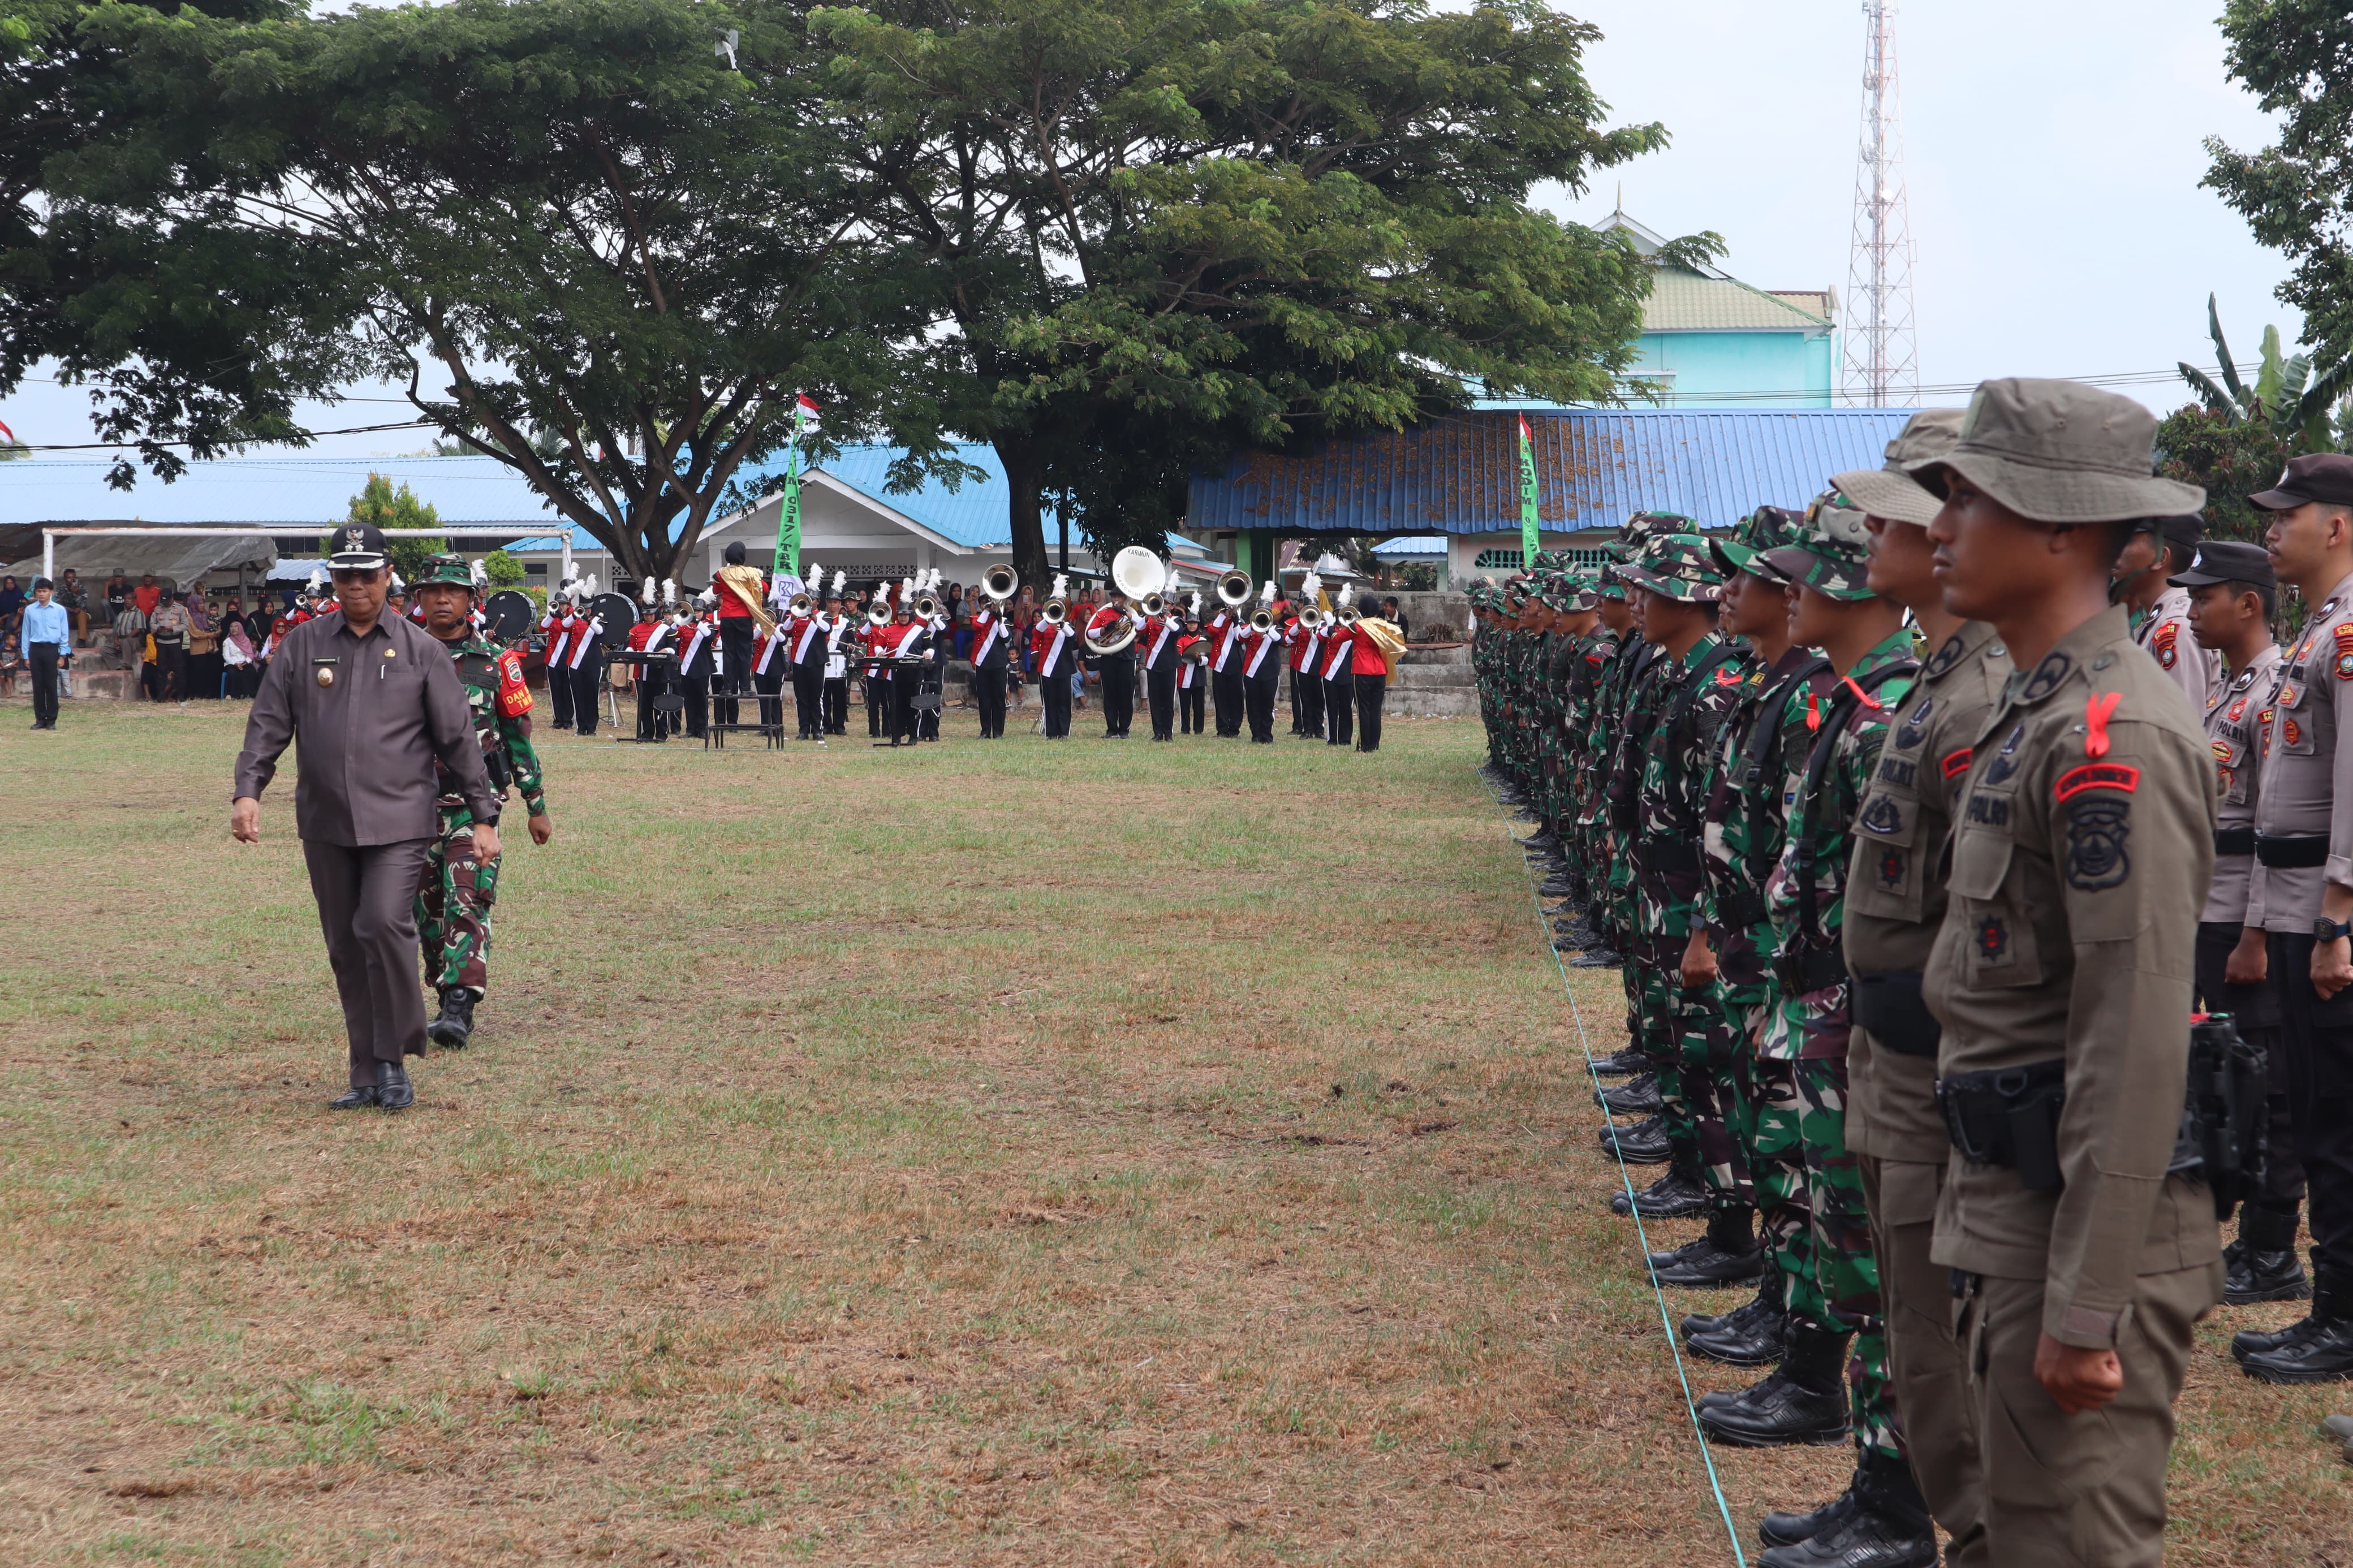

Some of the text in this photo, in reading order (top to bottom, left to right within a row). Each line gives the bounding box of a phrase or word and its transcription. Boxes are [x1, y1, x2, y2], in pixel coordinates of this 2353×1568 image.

[1520, 459, 1532, 505] KODIM
[1127, 548, 1150, 558] KARIMUN
[1117, 573, 1143, 597] MARCHING
[506, 689, 525, 705] DAN
[2217, 721, 2243, 741] POLRI
[1877, 758, 1916, 787] POLRI
[1969, 794, 2009, 826] POLRI
